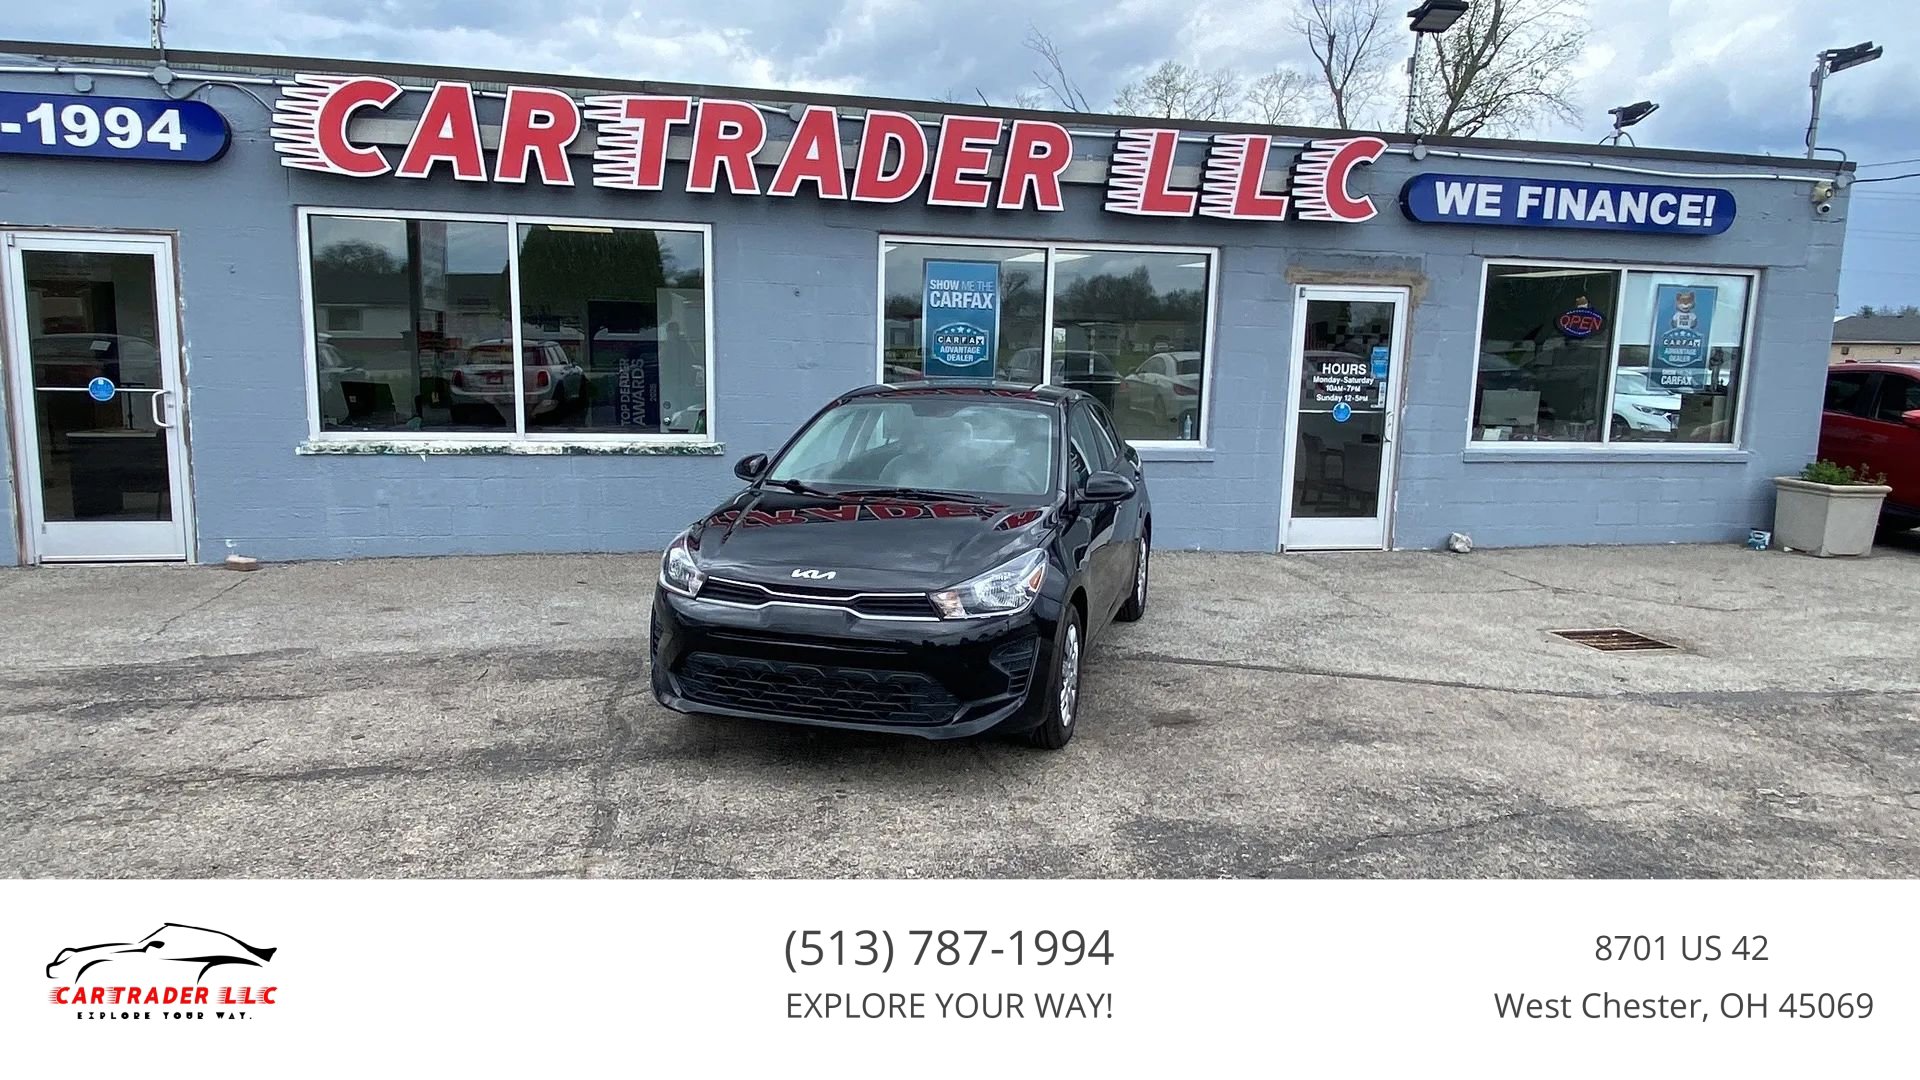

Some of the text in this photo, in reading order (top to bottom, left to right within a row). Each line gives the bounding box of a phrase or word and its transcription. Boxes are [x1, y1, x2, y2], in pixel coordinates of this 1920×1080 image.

[270, 73, 1389, 223] CAR TRADER LLC
[1435, 181, 1716, 227] WE FINANCE!
[929, 279, 994, 292] SHOW ME THE
[929, 290, 994, 309] CARFAX
[1560, 314, 1602, 330] OPEN
[940, 346, 981, 354] ADVANTAGE
[946, 354, 974, 362] DEALER
[1322, 363, 1367, 375] HOURS
[1661, 375, 1692, 385] CARFAX
[632, 358, 646, 427] AWARDS
[1316, 394, 1342, 403] Sunday
[620, 404, 631, 427] TOP
[791, 569, 836, 580] KIA
